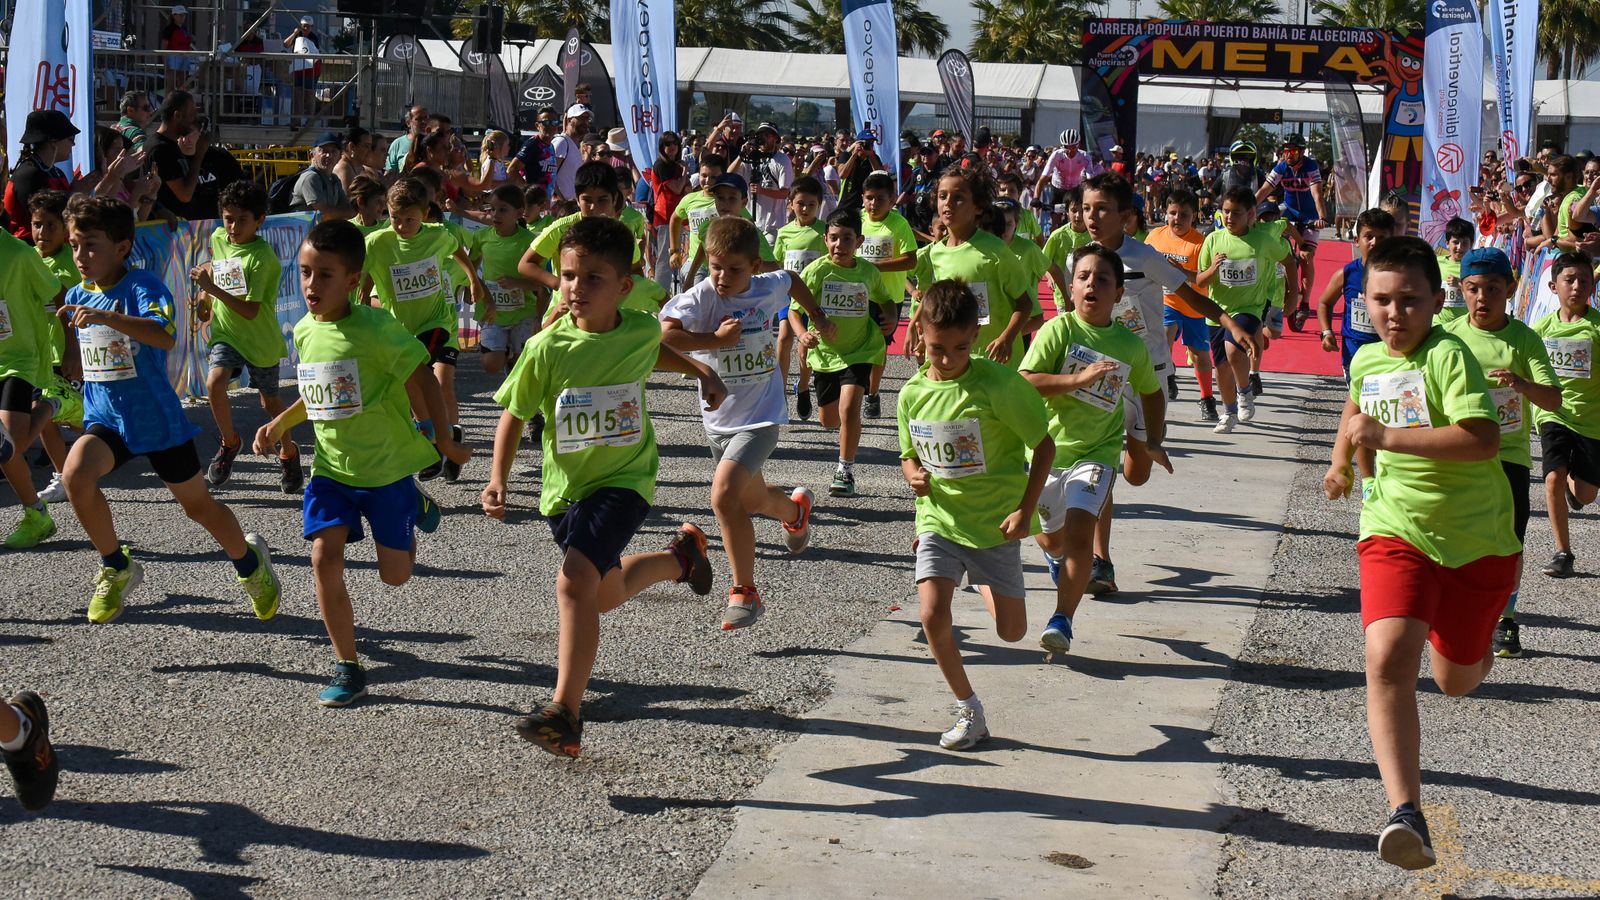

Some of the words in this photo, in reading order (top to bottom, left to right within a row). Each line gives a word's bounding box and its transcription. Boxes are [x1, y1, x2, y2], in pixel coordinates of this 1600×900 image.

[1090, 22, 1142, 35] CARRERA
[1148, 23, 1200, 37] POPULAR
[1204, 25, 1248, 38] PUERTO
[1252, 26, 1288, 40] BAHÍA
[1292, 28, 1306, 40] DE
[1310, 29, 1374, 44] ALGECIRAS
[1088, 58, 1126, 66] Algeciras
[1152, 40, 1373, 76] META
[197, 172, 216, 184] ILA
[860, 245, 880, 256] 1495
[396, 274, 426, 292] 1240
[1222, 269, 1244, 280] 1561
[825, 294, 854, 308] 1425
[82, 346, 108, 366] 1047
[723, 351, 764, 372] 1184
[302, 383, 333, 404] 1201
[560, 394, 574, 405] XXI
[1364, 399, 1399, 424] 1487
[562, 409, 617, 436] 1015
[917, 440, 956, 463] 1119
